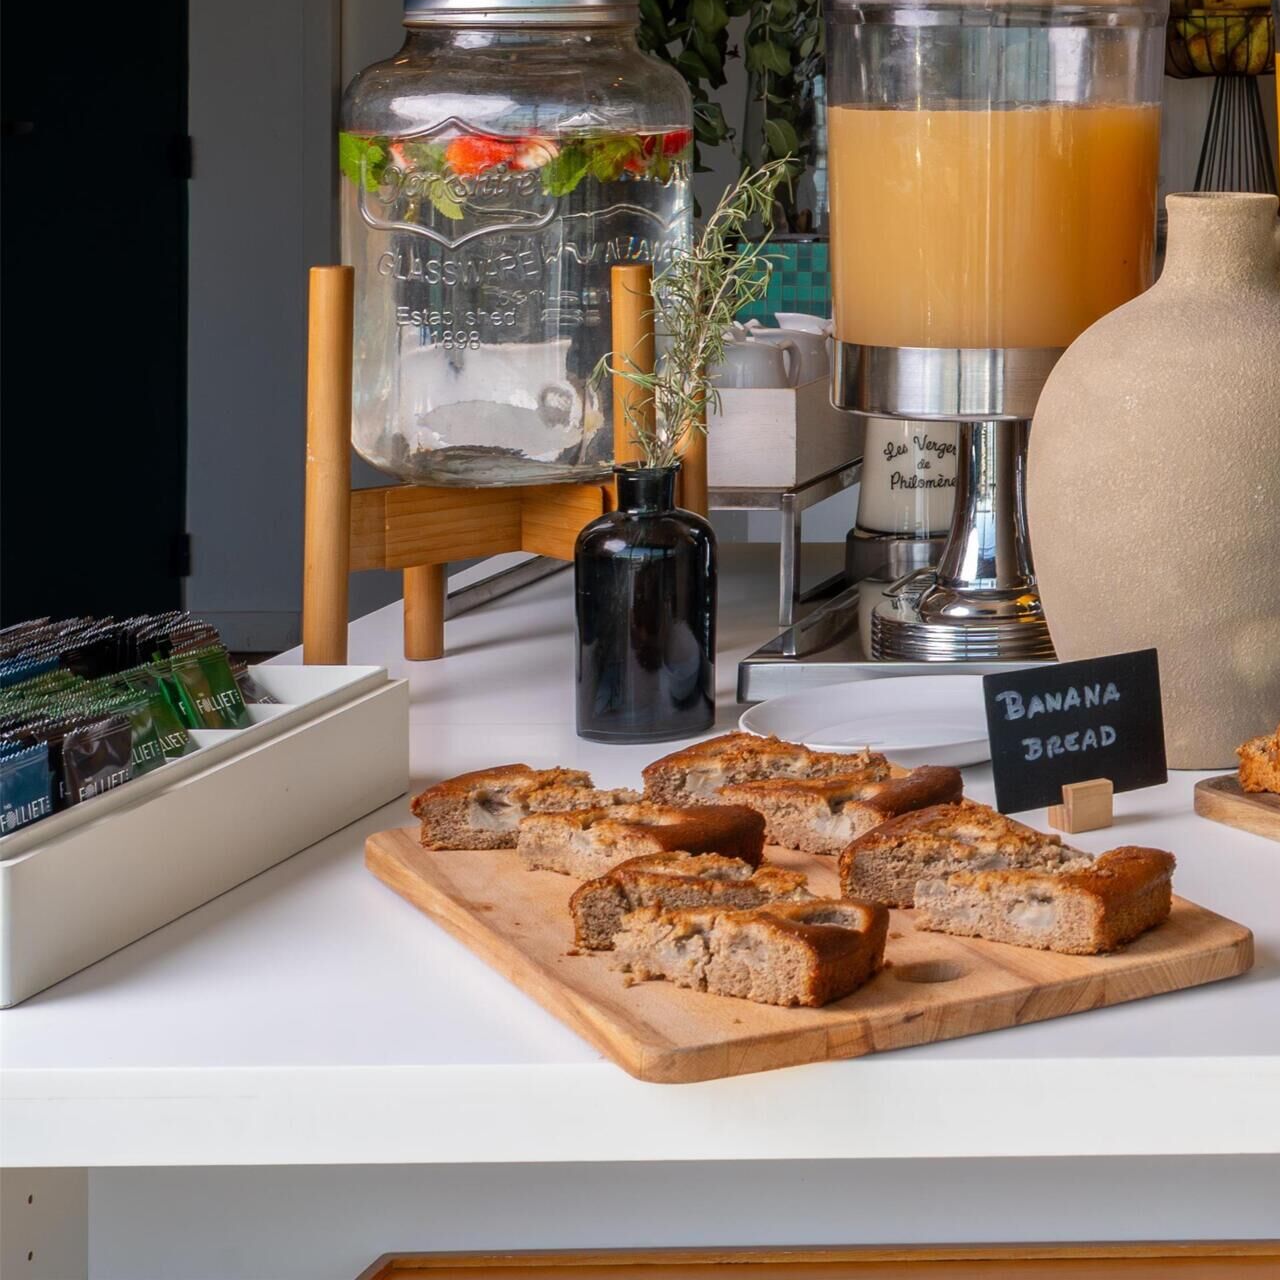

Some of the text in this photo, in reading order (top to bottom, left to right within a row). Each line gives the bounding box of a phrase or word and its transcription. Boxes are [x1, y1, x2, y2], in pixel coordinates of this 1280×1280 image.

[430, 330, 481, 350] 1898
[883, 442, 908, 461] Les
[917, 459, 931, 470] de
[890, 471, 959, 490] Philomène
[996, 682, 1121, 721] BANANA
[1022, 725, 1117, 761] BREAD
